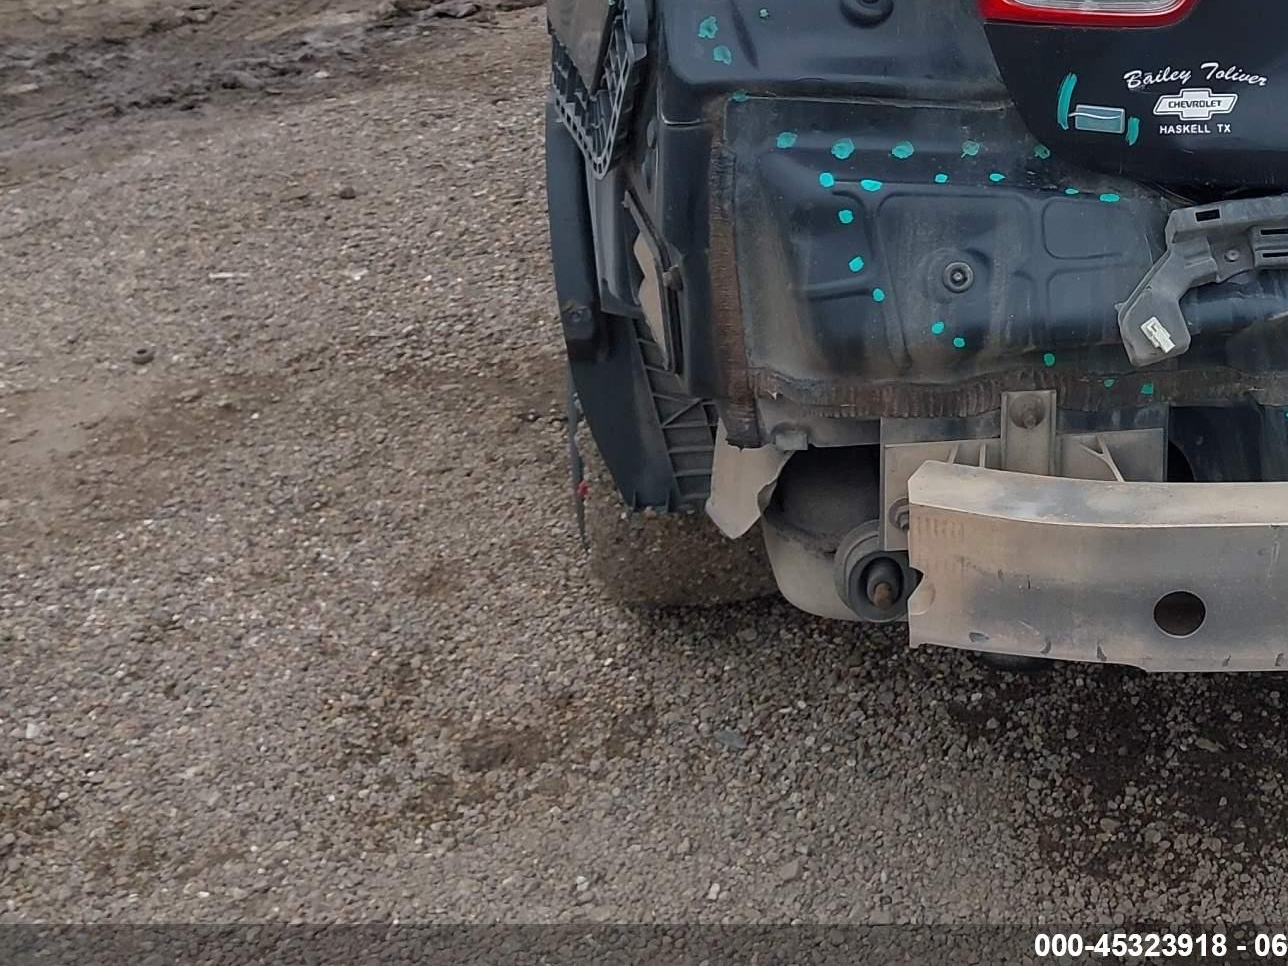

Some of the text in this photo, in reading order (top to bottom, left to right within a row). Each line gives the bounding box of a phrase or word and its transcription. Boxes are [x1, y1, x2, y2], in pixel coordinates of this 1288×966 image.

[1123, 62, 1268, 90] Bailey Toliver
[1168, 99, 1222, 109] CHEVROLET
[1159, 123, 1231, 134] HASKELL TX
